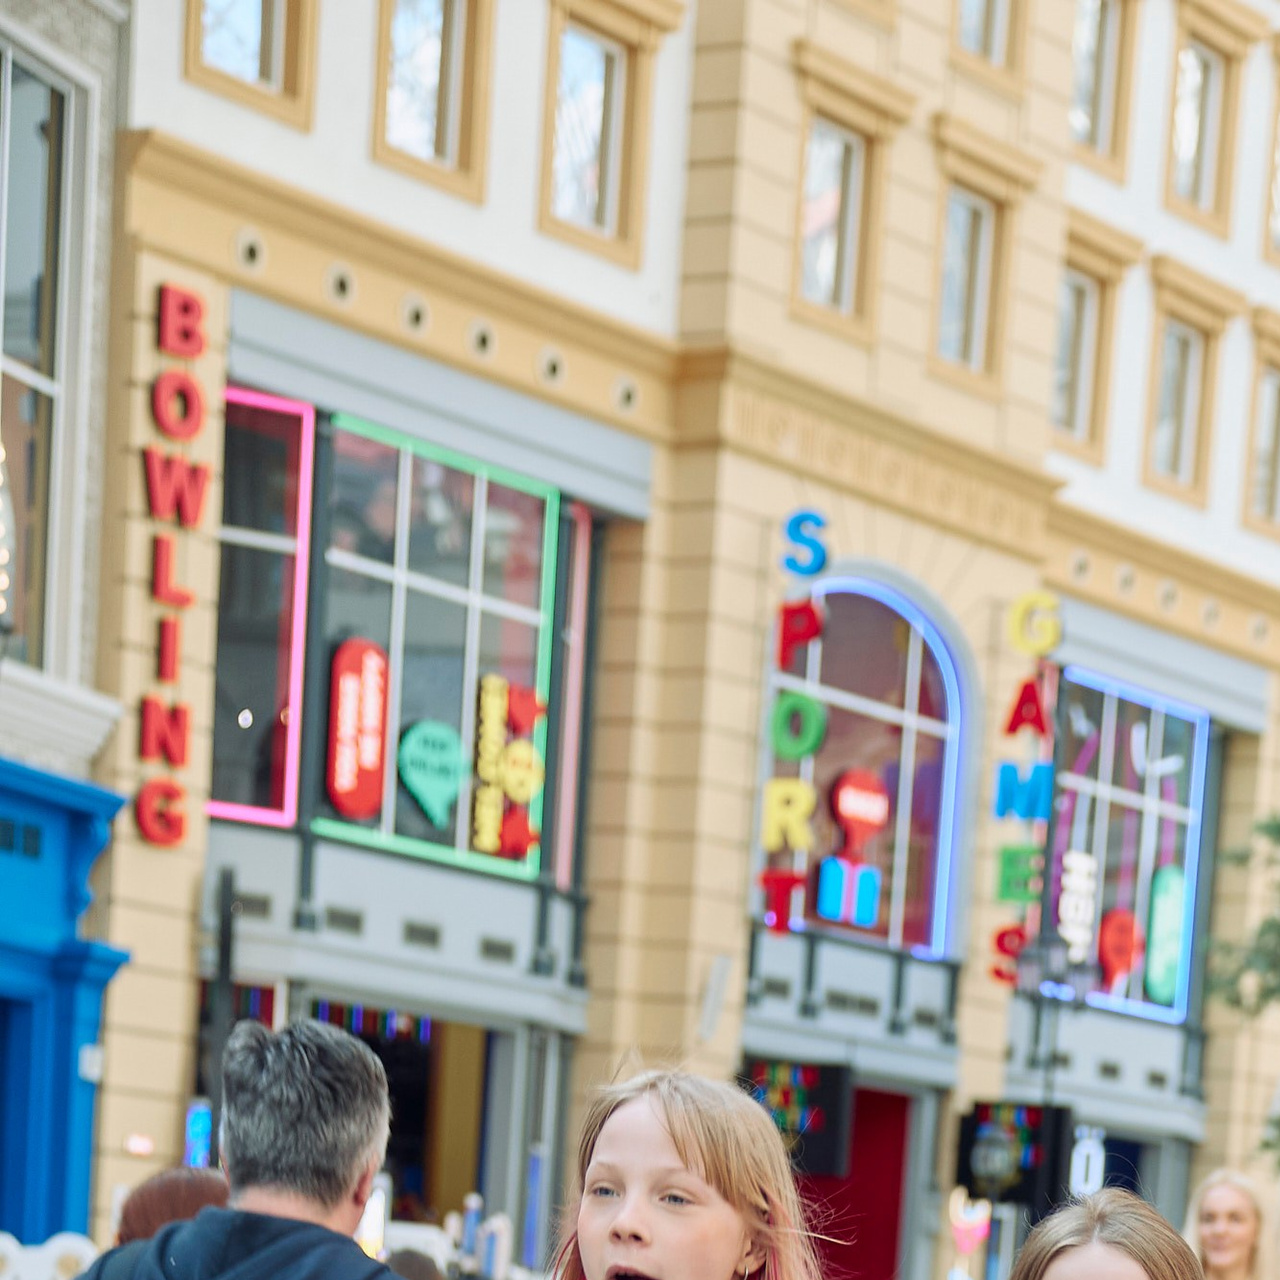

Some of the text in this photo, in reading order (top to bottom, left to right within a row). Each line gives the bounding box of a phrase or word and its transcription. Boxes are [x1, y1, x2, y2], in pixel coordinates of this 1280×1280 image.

[136, 283, 209, 847] BOWLING
[758, 510, 829, 937] SPORT
[992, 593, 1062, 985] GAMES
